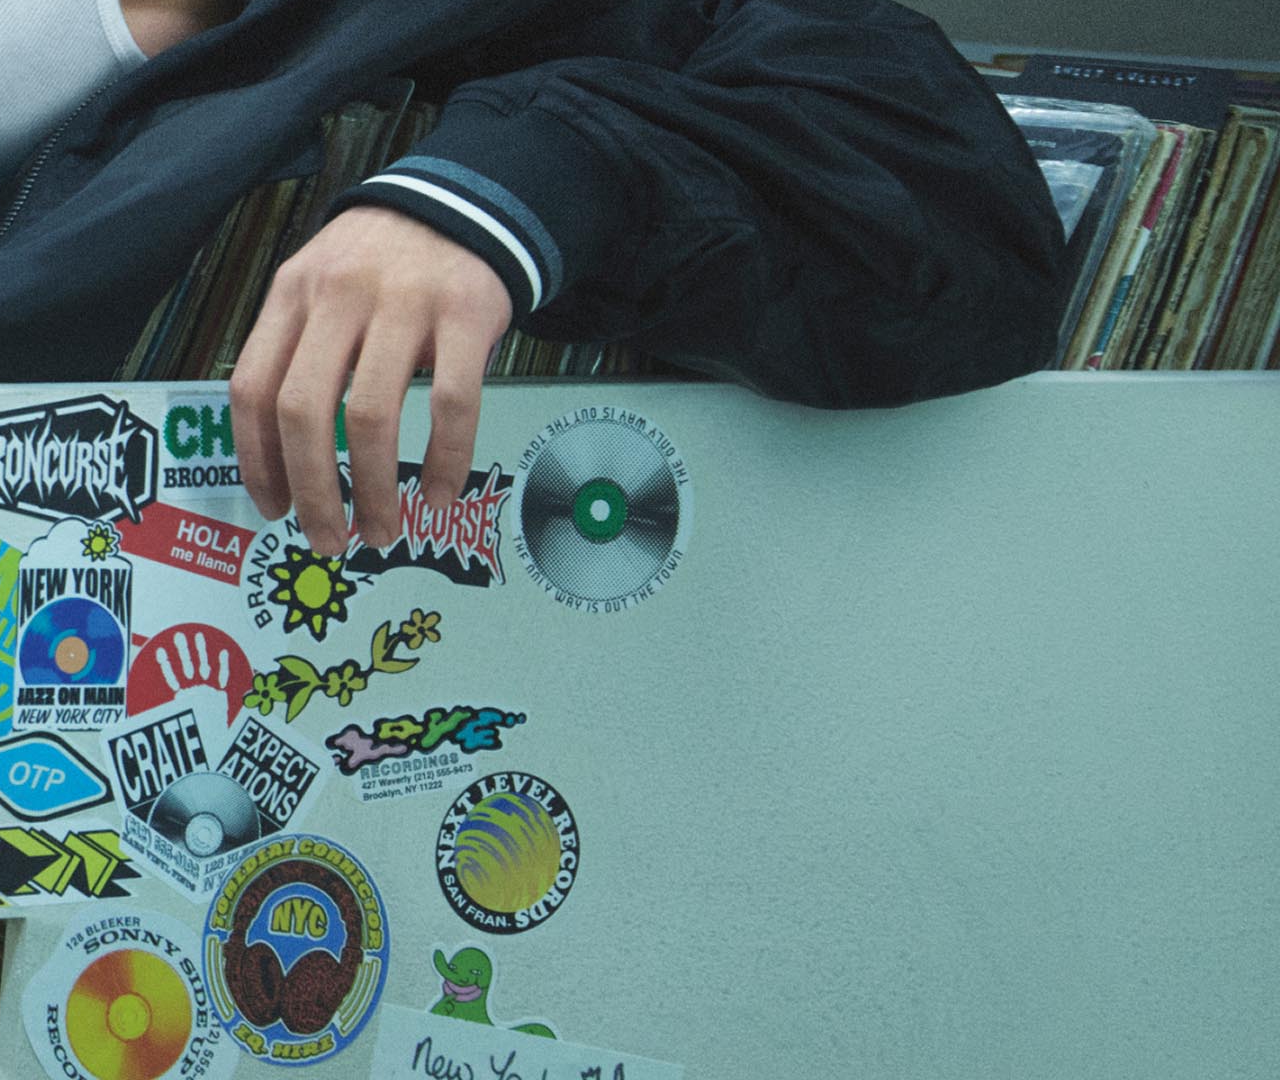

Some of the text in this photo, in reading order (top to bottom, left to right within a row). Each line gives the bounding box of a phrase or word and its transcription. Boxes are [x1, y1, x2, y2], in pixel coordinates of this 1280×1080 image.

[176, 519, 241, 558] HOLA
[171, 544, 237, 576] me llamo
[19, 568, 129, 629] NEW YORK
[247, 532, 280, 630] BRAND
[605, 598, 629, 614] OUT
[631, 584, 655, 606] THE
[654, 549, 684, 585] TOWN
[17, 687, 126, 706] JAZZ ON MAIN
[17, 708, 124, 725] NEW YORK CITY
[115, 713, 208, 803] CRATE
[235, 722, 317, 790] EXPECT
[359, 752, 459, 780] RECORDINGS
[8, 761, 67, 793] OTP
[219, 751, 298, 823] ATIONS
[361, 780, 376, 790] 427
[378, 775, 412, 788] Waverly
[414, 770, 435, 783] (212)
[363, 780, 443, 802] Brooklyn, NY 11222
[439, 773, 577, 929] NEXT LEVEL RECORDS
[298, 838, 383, 949] CONNECTOR
[444, 874, 467, 908] SAN
[66, 916, 141, 951] 128 BLEEKER
[271, 897, 328, 938] NYC
[82, 927, 209, 1077] SONNY SIDE UP
[47, 1003, 89, 1080] RECO
[272, 1033, 335, 1059] HIRE
